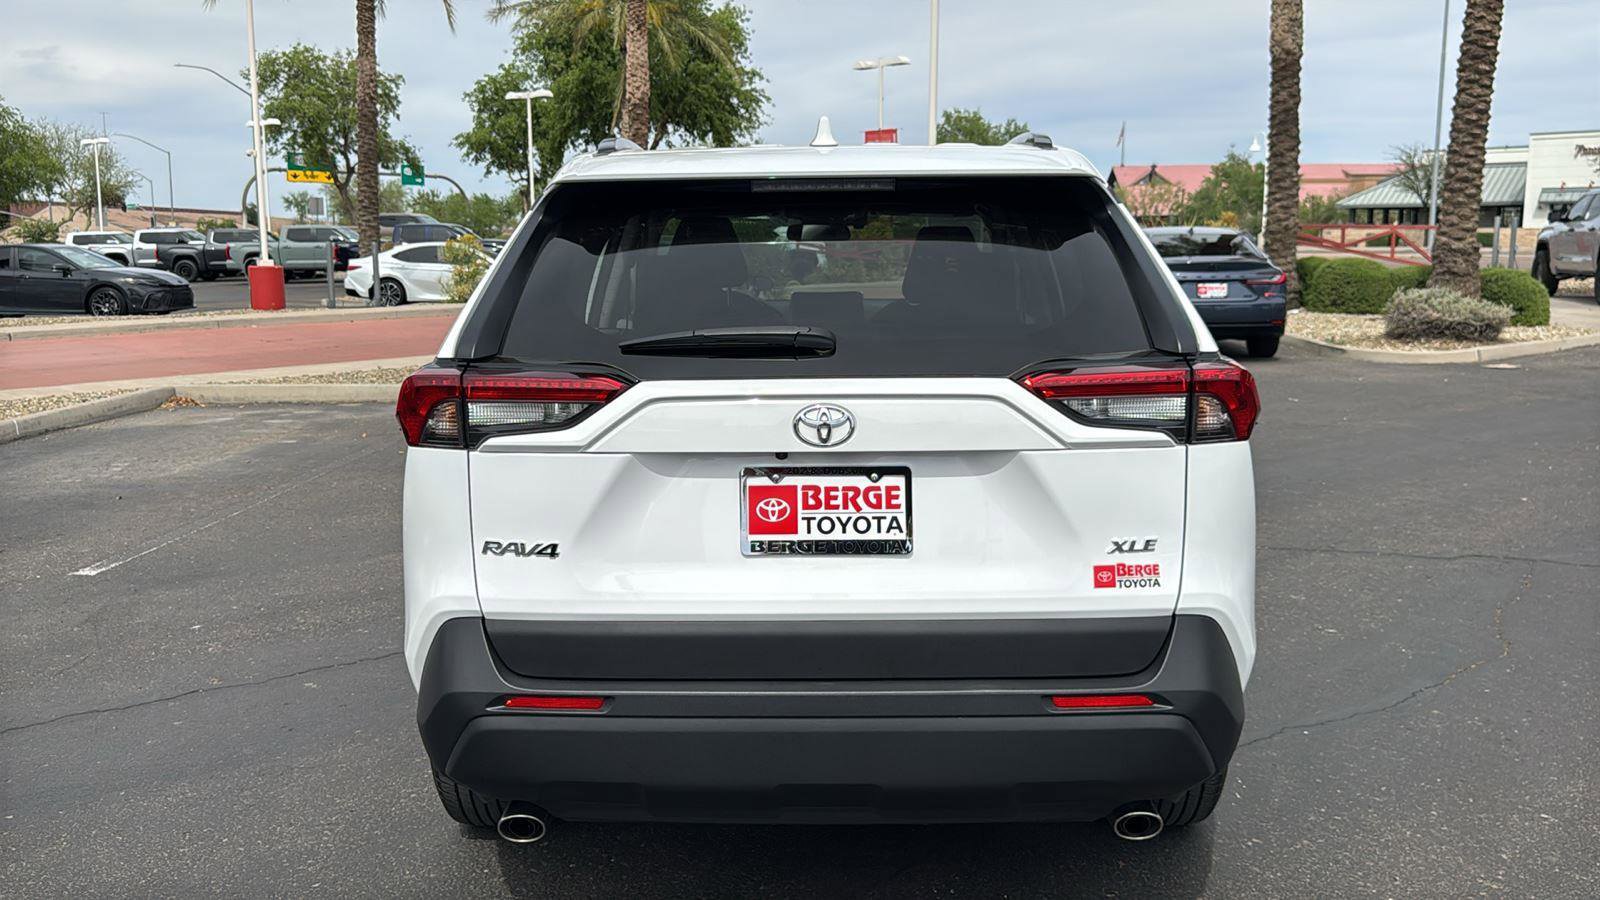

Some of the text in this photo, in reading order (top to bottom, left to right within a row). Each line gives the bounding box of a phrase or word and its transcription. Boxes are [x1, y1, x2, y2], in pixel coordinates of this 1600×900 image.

[801, 485, 901, 512] BERGE
[801, 516, 904, 535] TOYOTA
[481, 540, 561, 559] RAV4
[750, 540, 905, 553] BERGE TOYOTA
[1107, 539, 1158, 554] XLE
[1116, 563, 1161, 577] BERGE
[1117, 579, 1161, 588] TOYOTA
